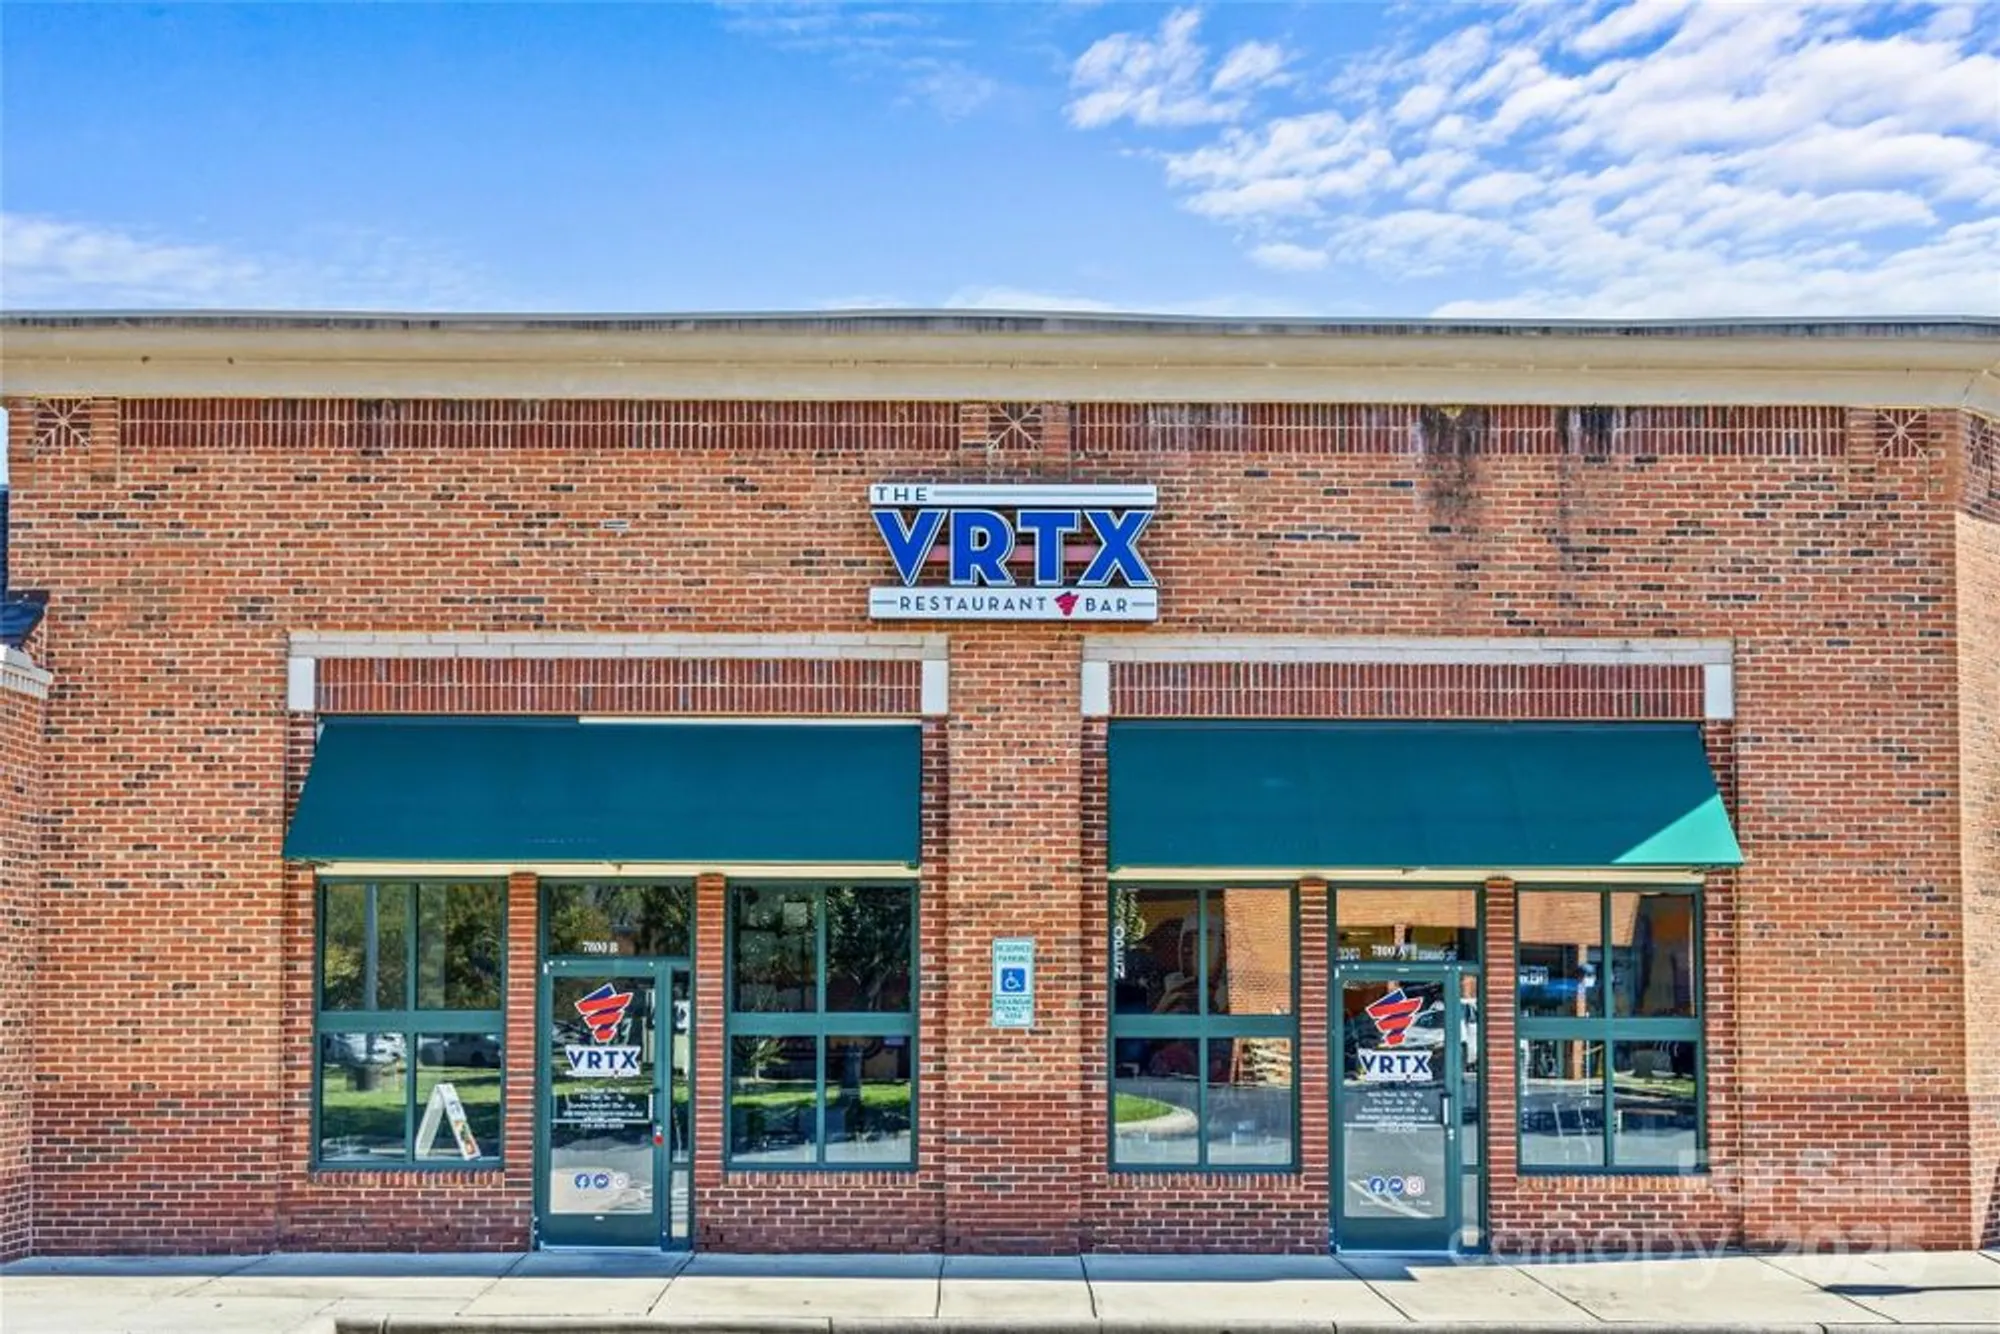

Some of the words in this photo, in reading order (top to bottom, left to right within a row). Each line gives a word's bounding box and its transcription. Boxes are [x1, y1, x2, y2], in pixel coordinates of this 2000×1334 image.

[874, 486, 928, 502] THE
[871, 508, 1159, 587] VRTX
[899, 596, 1047, 612] RESTAURANT
[1085, 597, 1128, 613] BAR
[568, 1050, 637, 1069] VRTX
[1360, 1055, 1429, 1074] VRTX
